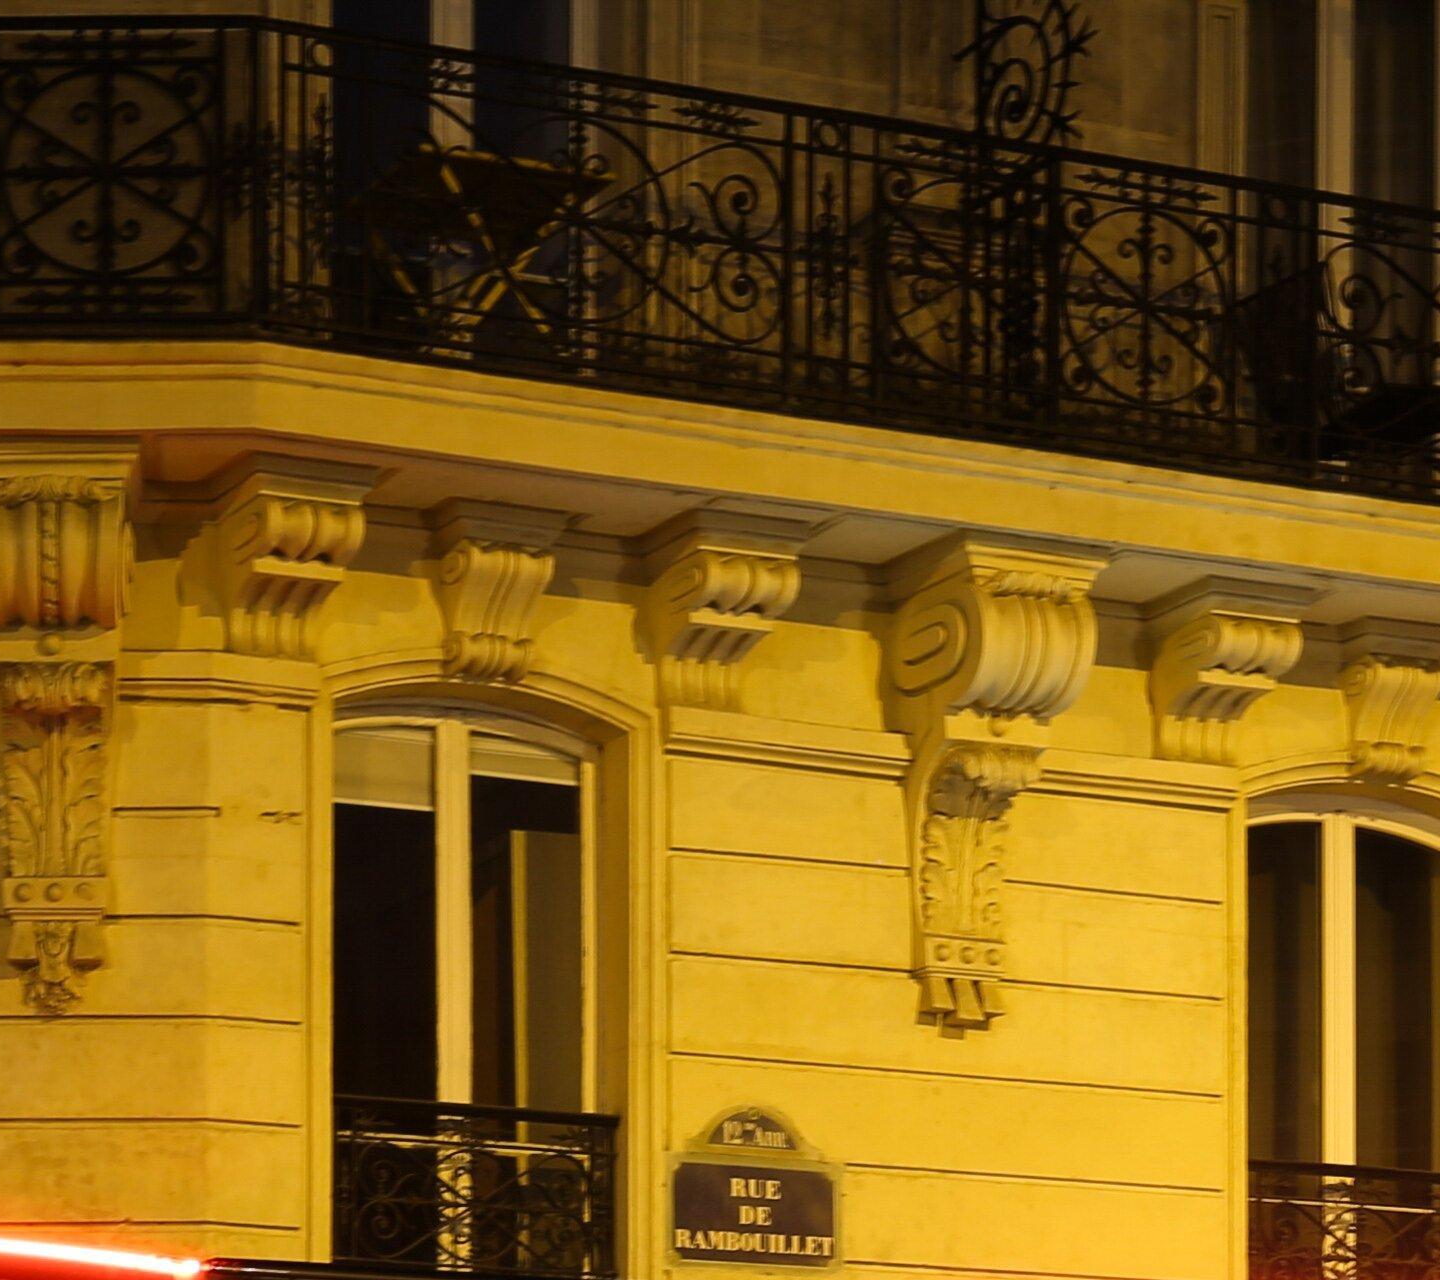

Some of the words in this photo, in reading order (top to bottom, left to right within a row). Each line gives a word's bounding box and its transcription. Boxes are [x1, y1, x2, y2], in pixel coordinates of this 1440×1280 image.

[730, 1177, 783, 1200] RUE
[738, 1205, 773, 1226] DE
[675, 1228, 835, 1257] RAMBOUILLET
